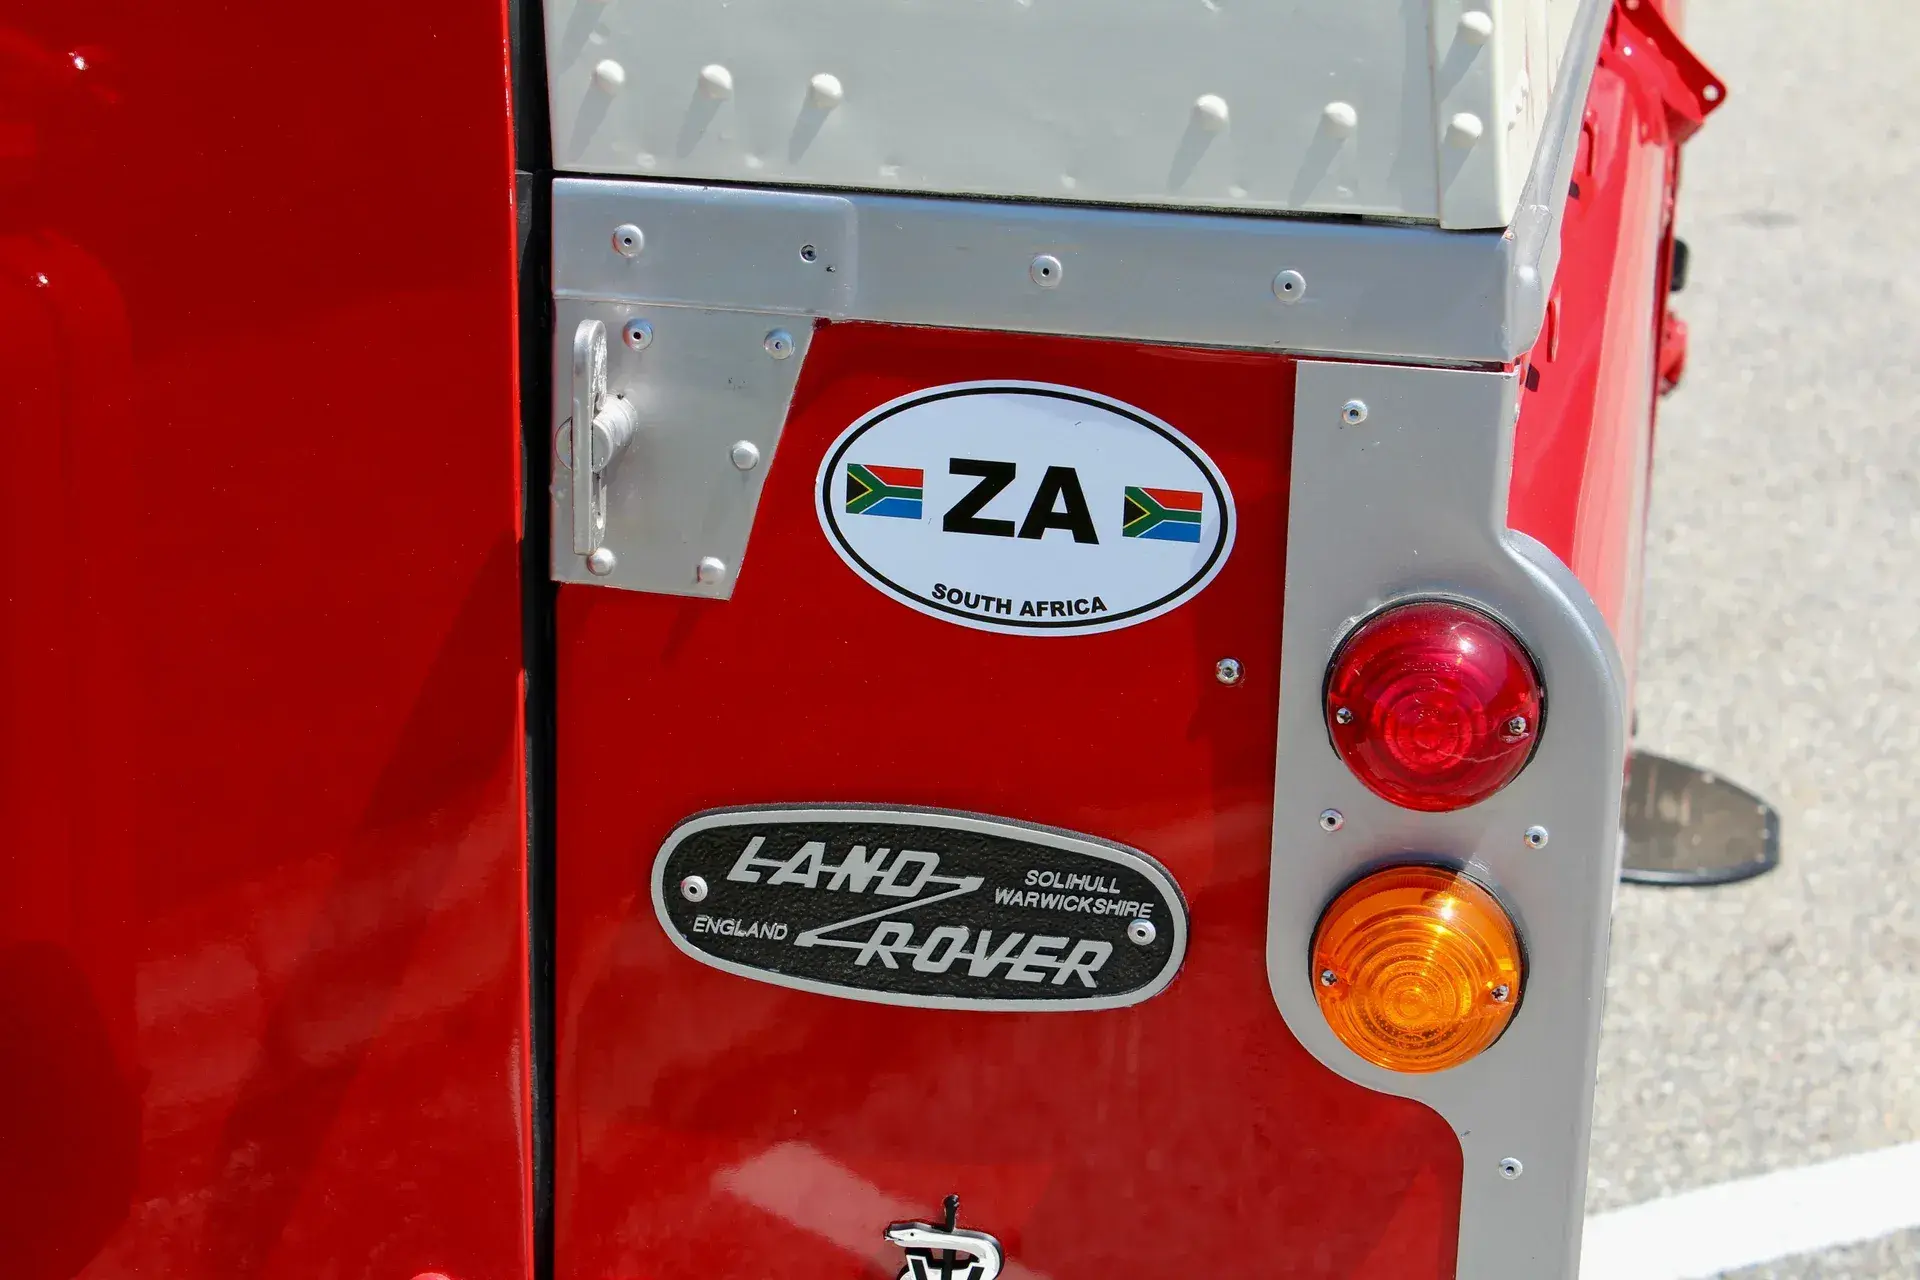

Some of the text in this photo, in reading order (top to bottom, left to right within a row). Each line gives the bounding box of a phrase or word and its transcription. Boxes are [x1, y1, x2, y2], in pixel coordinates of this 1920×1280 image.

[942, 457, 1100, 545] ZA
[931, 582, 1108, 617] SOUTH AFRICA
[727, 836, 941, 897] LAND
[1024, 869, 1121, 894] SOLIHULL
[994, 888, 1155, 918] WARWICKSHIRE
[692, 914, 789, 942] ENGLAND
[854, 922, 1114, 988] ROVER
